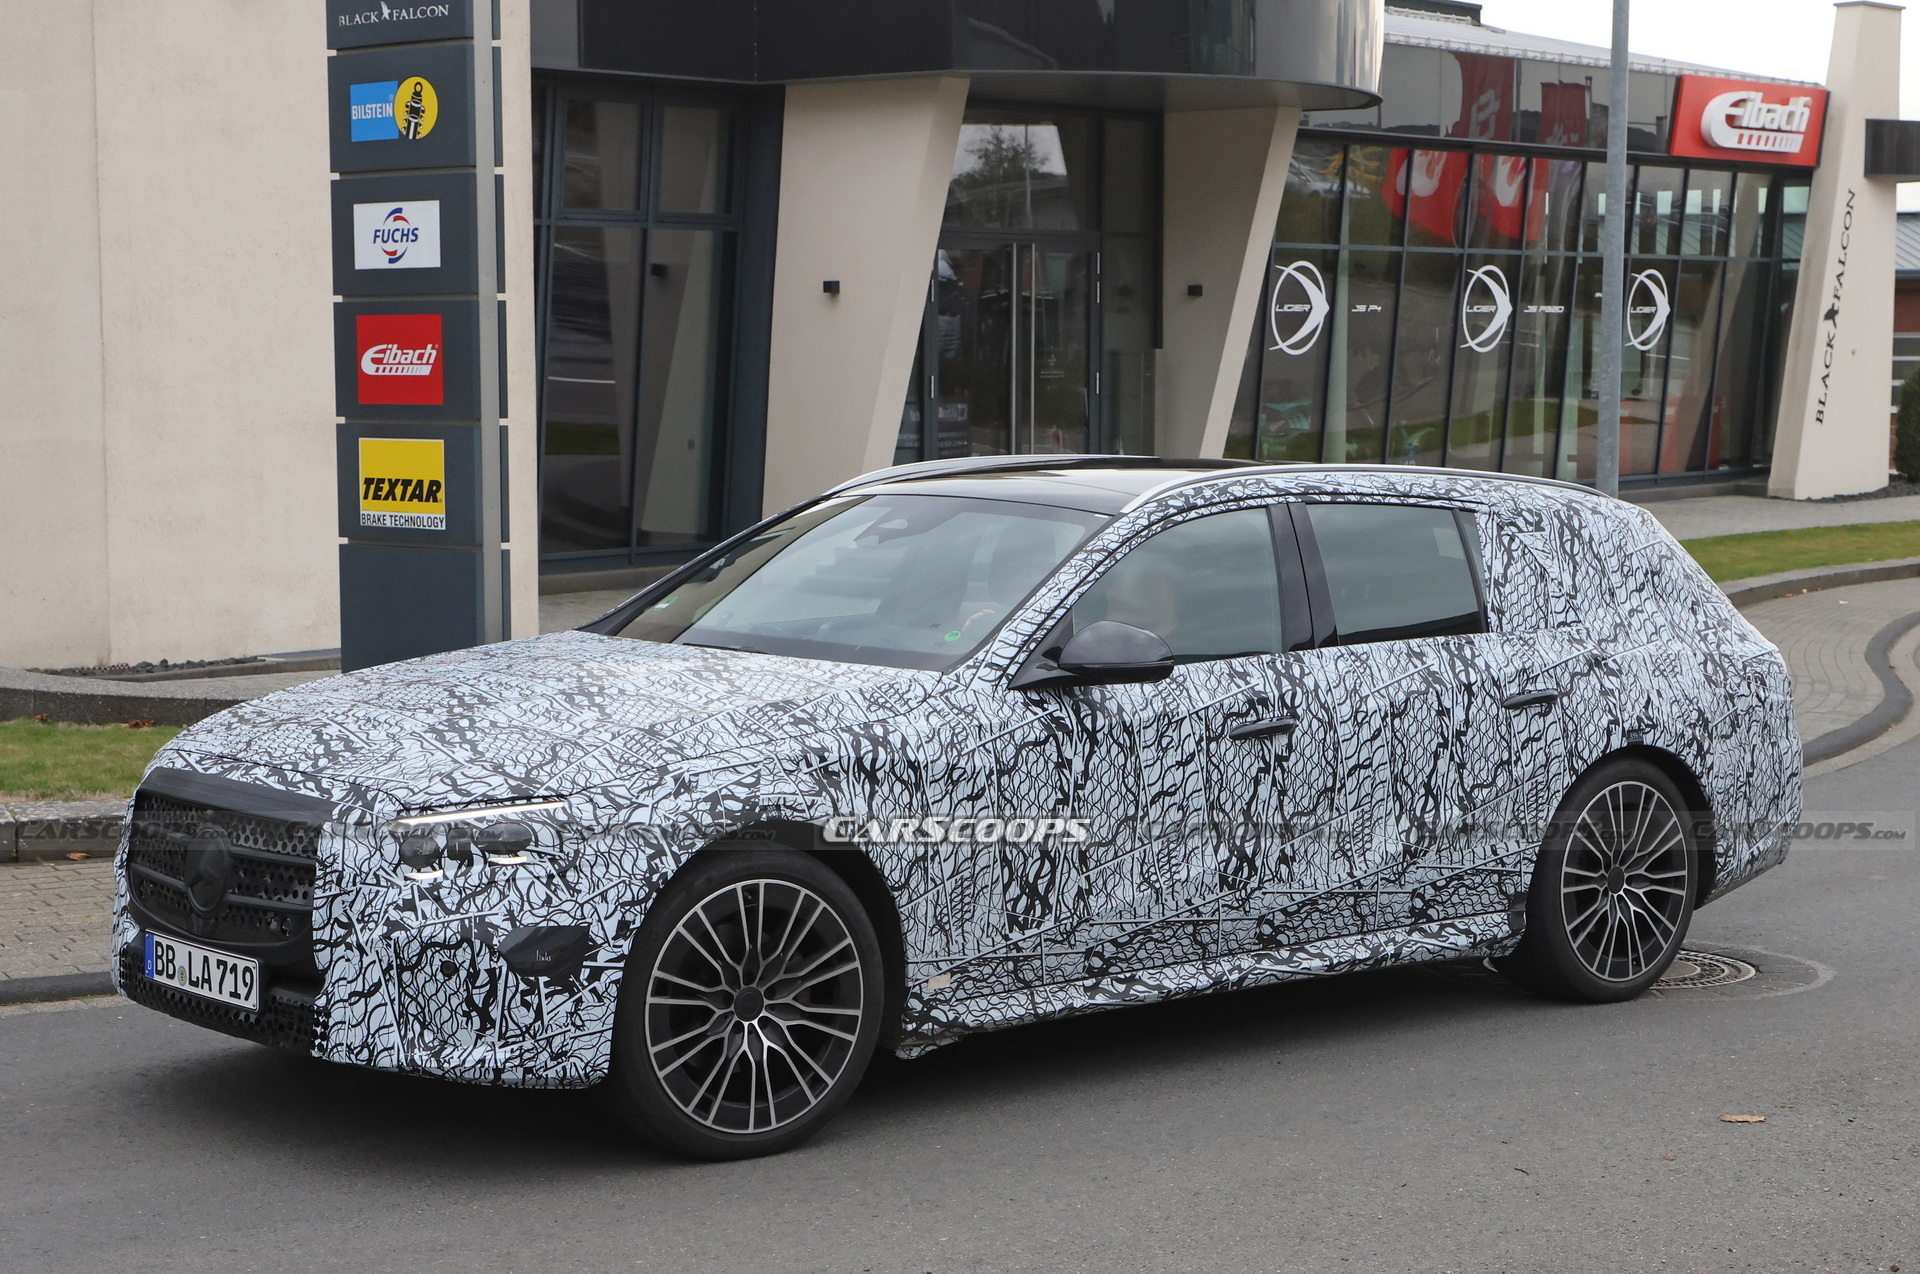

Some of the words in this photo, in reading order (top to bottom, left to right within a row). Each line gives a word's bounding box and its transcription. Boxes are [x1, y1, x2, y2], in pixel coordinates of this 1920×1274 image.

[338, 11, 379, 27] BLACK
[392, 4, 450, 21] FALCON
[351, 102, 394, 120] BILSTEIN
[1700, 90, 1813, 153] Eibach
[373, 227, 419, 244] FUCHS
[1815, 331, 1837, 426] BLACK
[1833, 188, 1856, 302] FALCON
[360, 343, 439, 376] Eibach
[362, 477, 442, 503] TEXTAR
[361, 513, 387, 526] BRAKE
[389, 514, 445, 529] TECHNOLOGY
[147, 960, 152, 970] D
[155, 940, 176, 980] BB
